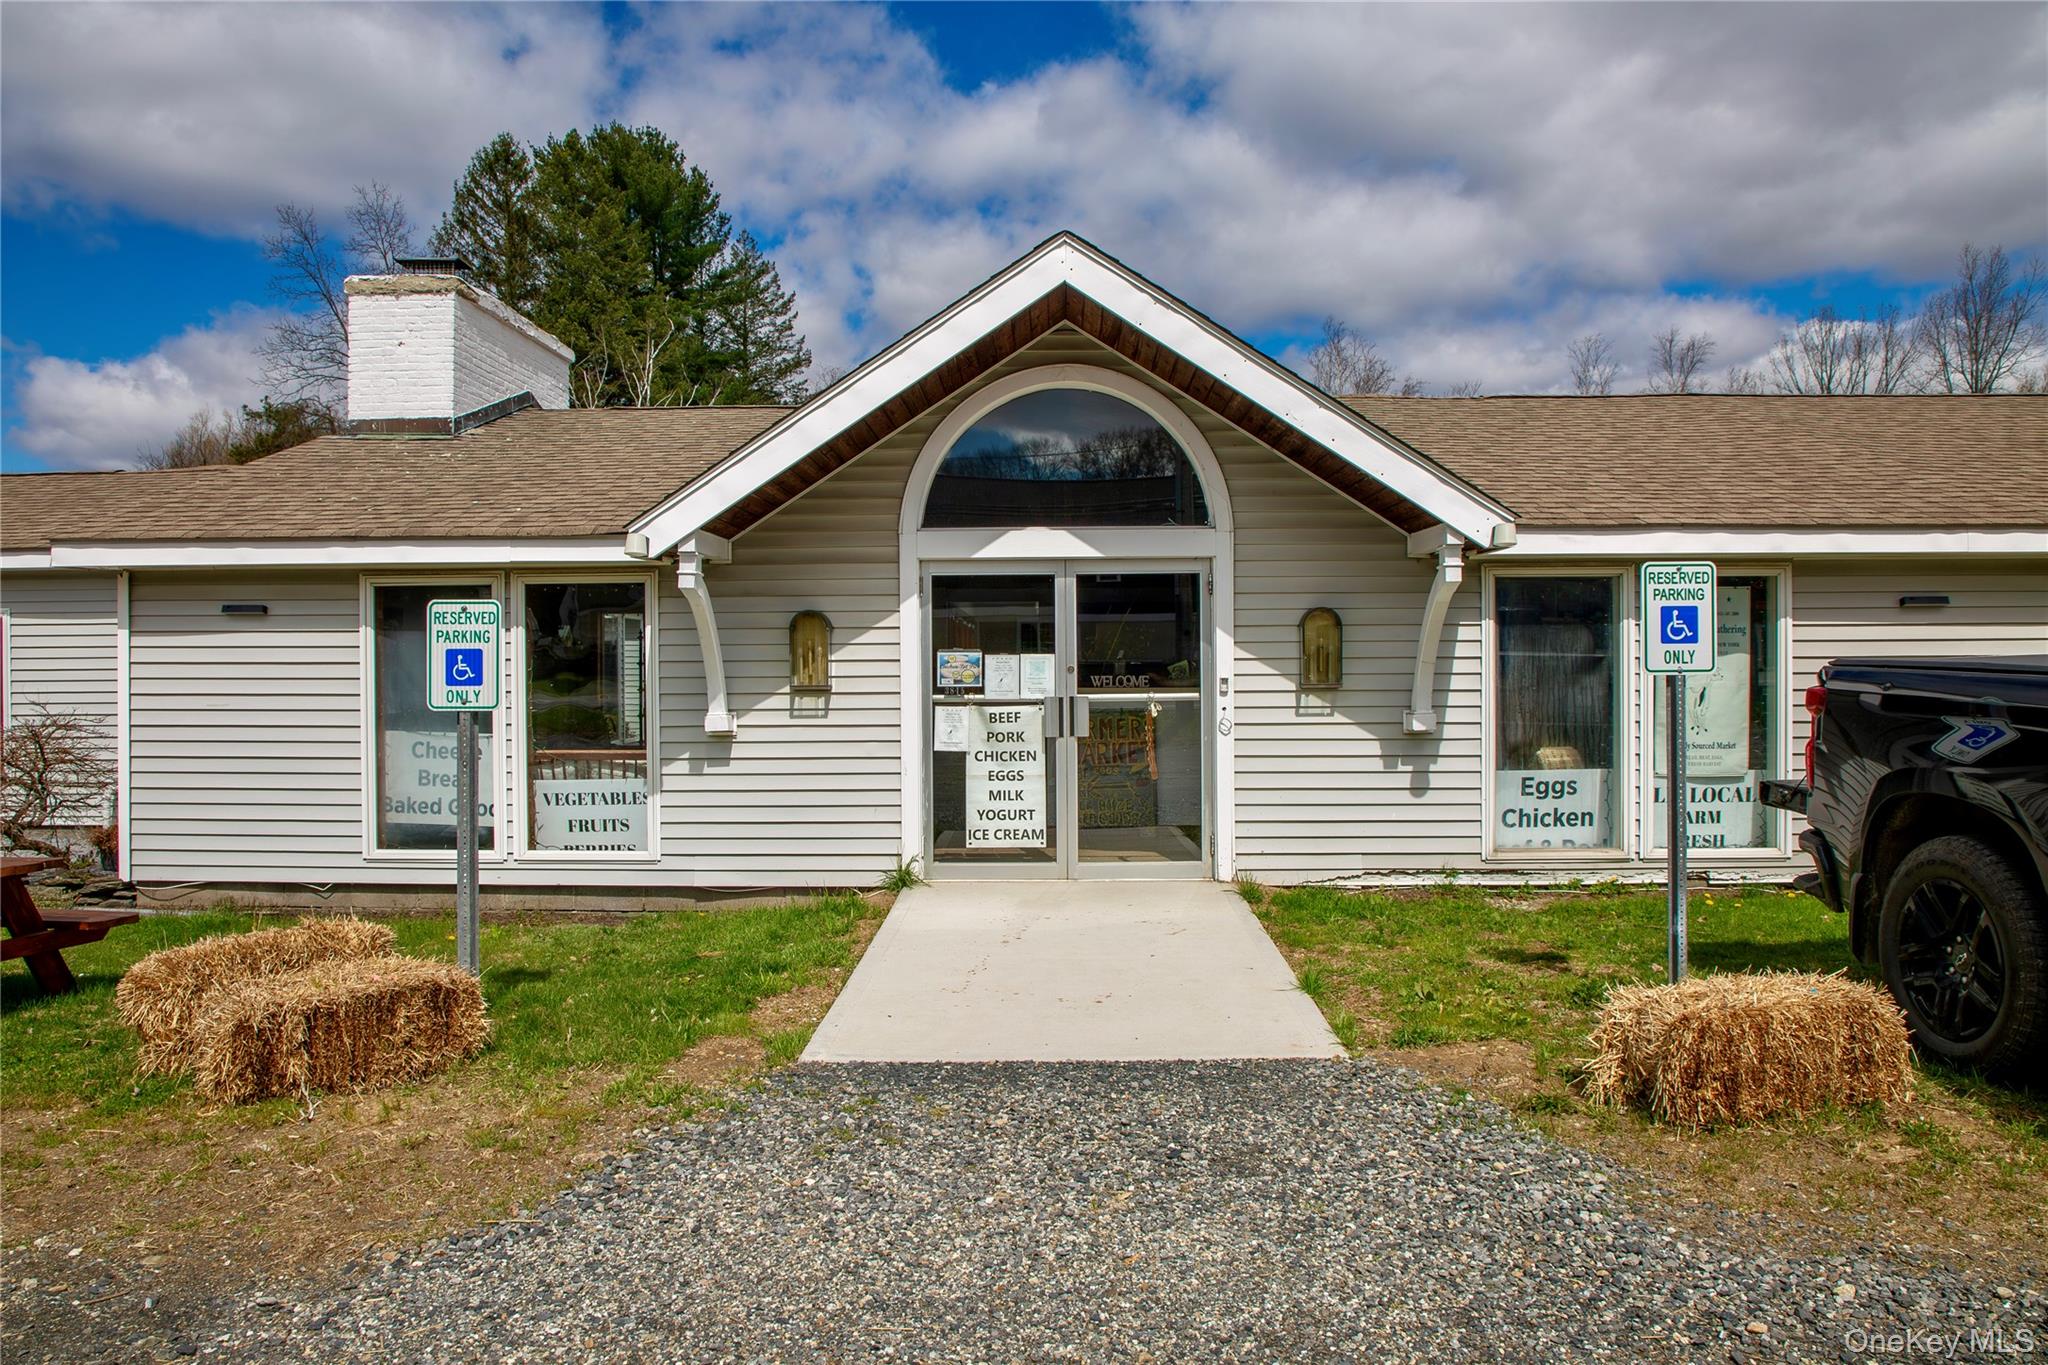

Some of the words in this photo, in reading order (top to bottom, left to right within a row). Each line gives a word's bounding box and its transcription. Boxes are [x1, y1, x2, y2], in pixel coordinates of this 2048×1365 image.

[1648, 571, 1710, 585] RESERVED
[1653, 587, 1705, 601] PARKING
[433, 611, 496, 625] RESERVED
[436, 630, 491, 644] PARKING
[1717, 624, 1746, 636] thering
[1663, 650, 1695, 664] ONLY
[1090, 675, 1150, 688] WELCOME
[446, 689, 481, 704] ONLY
[989, 712, 1021, 724] BEEF
[1089, 716, 1148, 740] RMER
[987, 731, 1025, 743] PORK
[412, 741, 482, 760] Chee
[1691, 742, 1715, 750] Sourced
[1716, 741, 1736, 750] Market
[974, 750, 1037, 763] CHICKEN
[1080, 741, 1149, 765] ARKET
[418, 769, 458, 787] Brea
[987, 769, 1024, 782] EGGS
[988, 789, 1024, 801] MILK
[1521, 776, 1578, 800] Eggs
[1690, 787, 1757, 803] LOCAL
[384, 796, 442, 815] Baked
[977, 808, 1036, 821] YOGURT
[1501, 807, 1594, 828] Chicken
[1686, 810, 1721, 824] ARM
[568, 818, 630, 832] FRUITS
[968, 828, 990, 841] ICE
[993, 828, 1044, 841] CREAM
[1686, 834, 1725, 848] ESH
